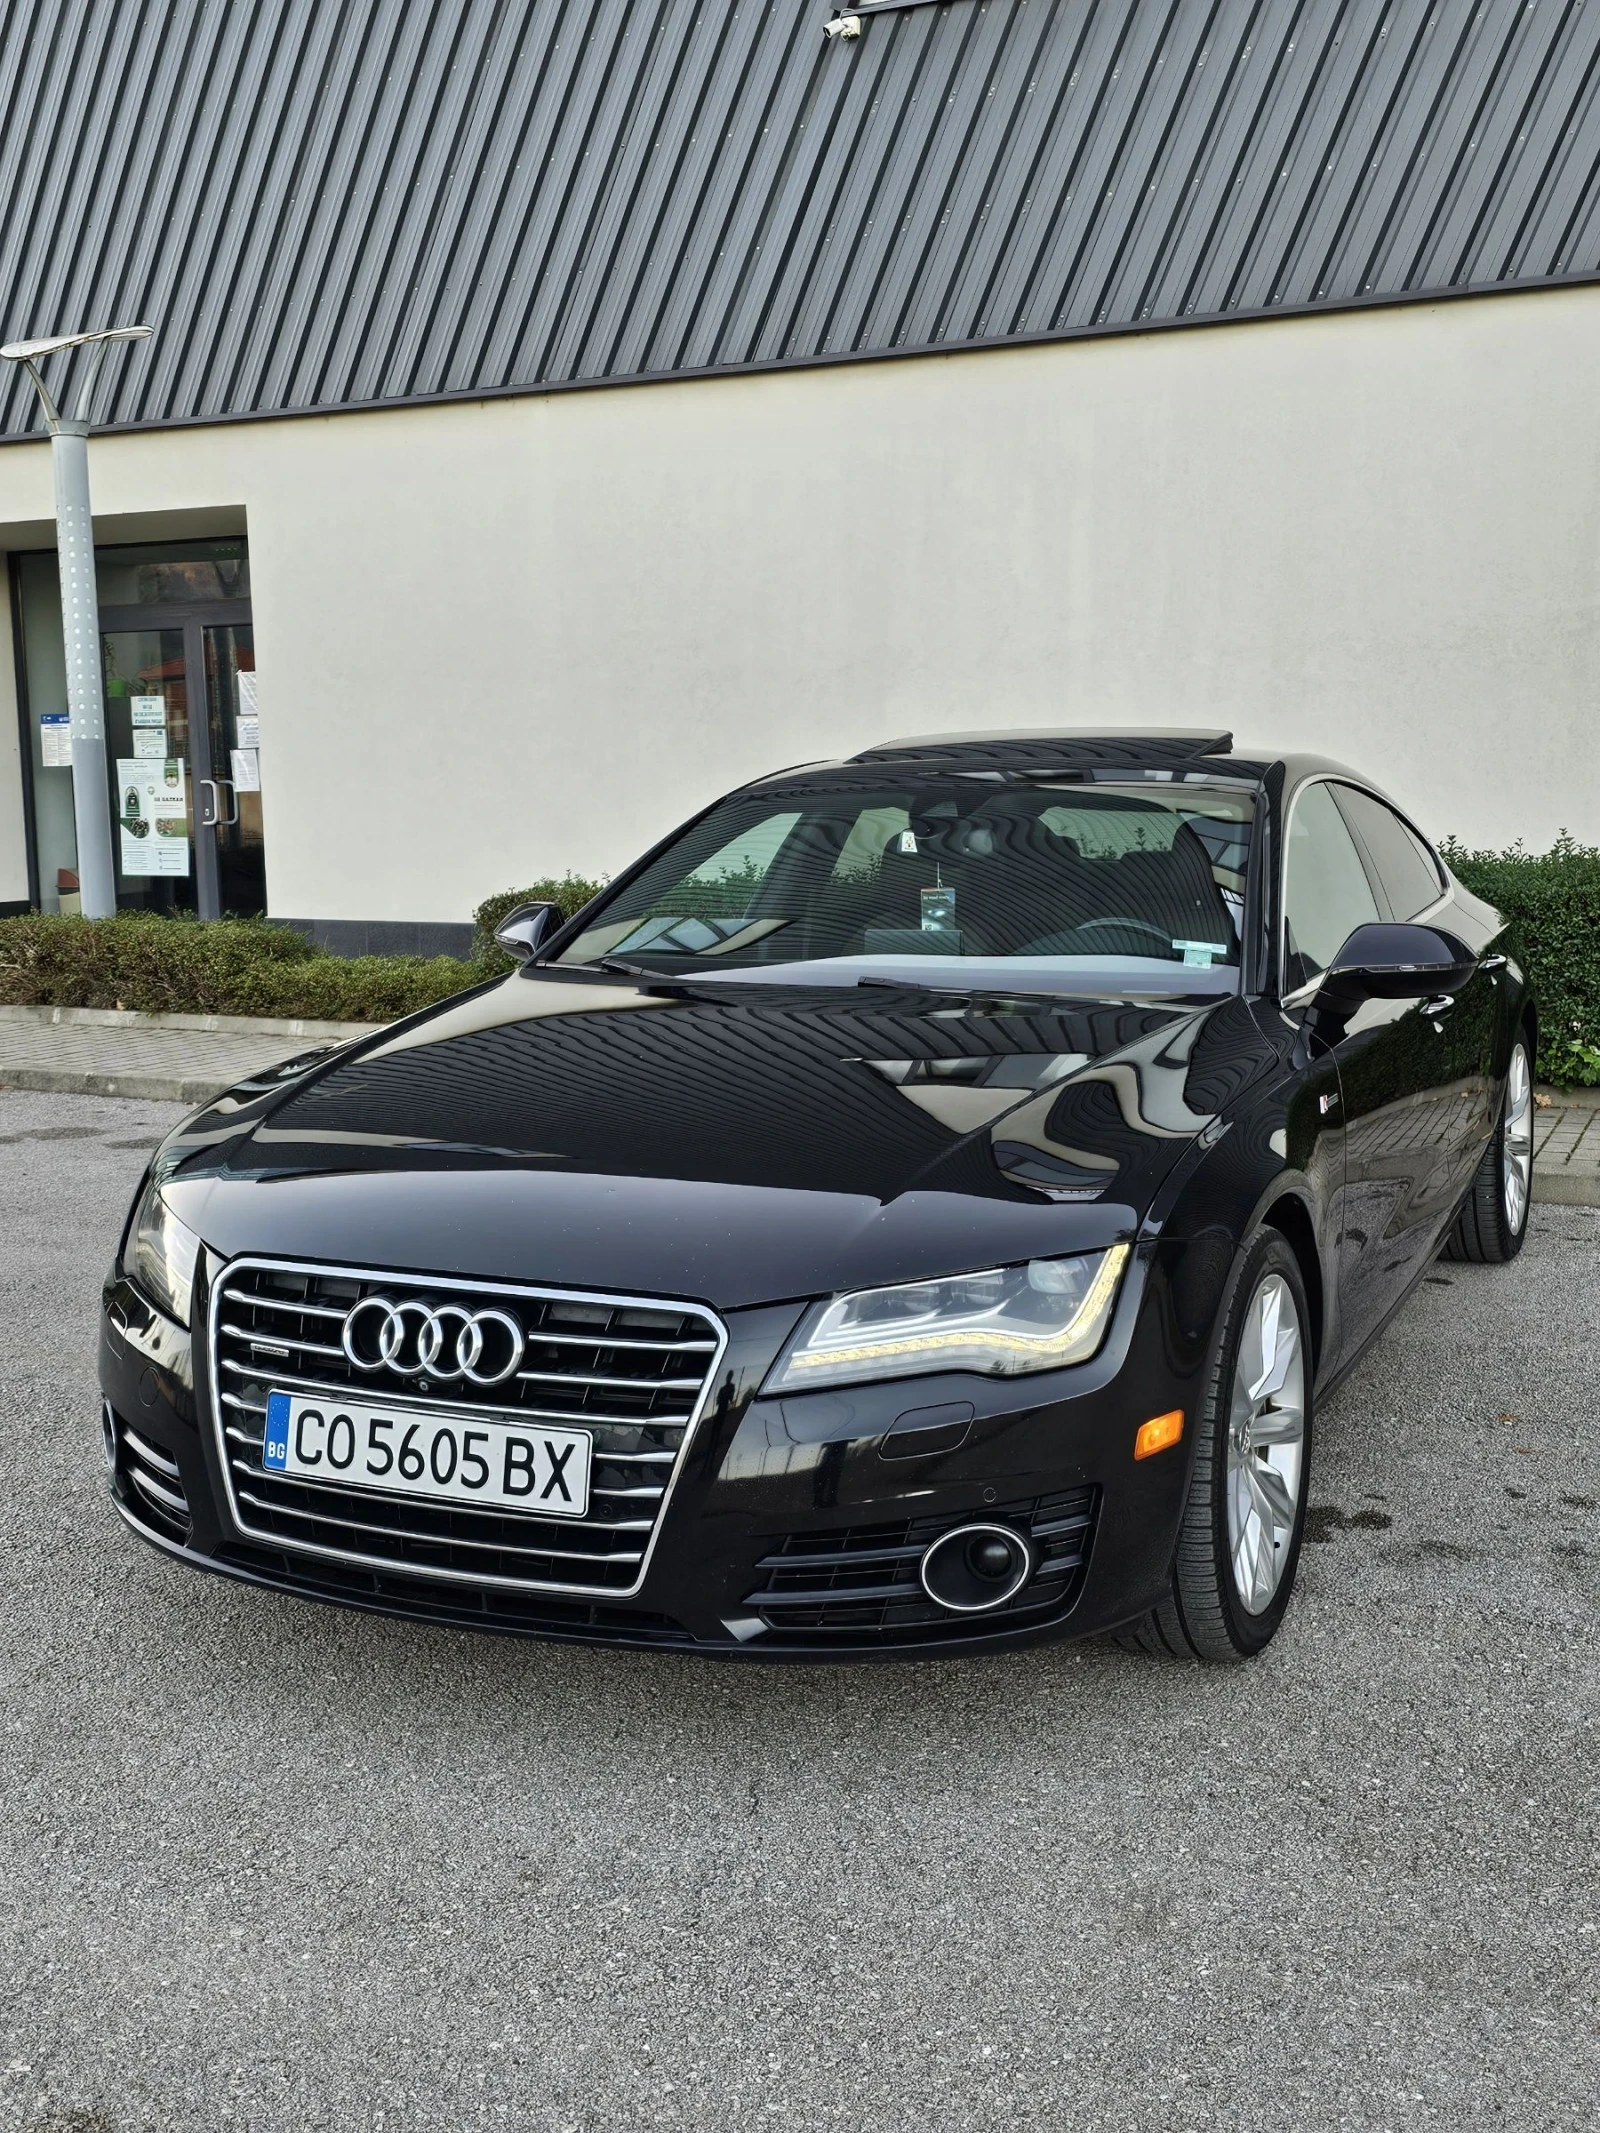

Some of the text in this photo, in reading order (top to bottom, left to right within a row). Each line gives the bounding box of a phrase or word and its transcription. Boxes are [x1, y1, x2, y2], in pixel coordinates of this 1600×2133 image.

[268, 1441, 286, 1460] BG
[295, 1409, 576, 1502] CO 5605 BX
